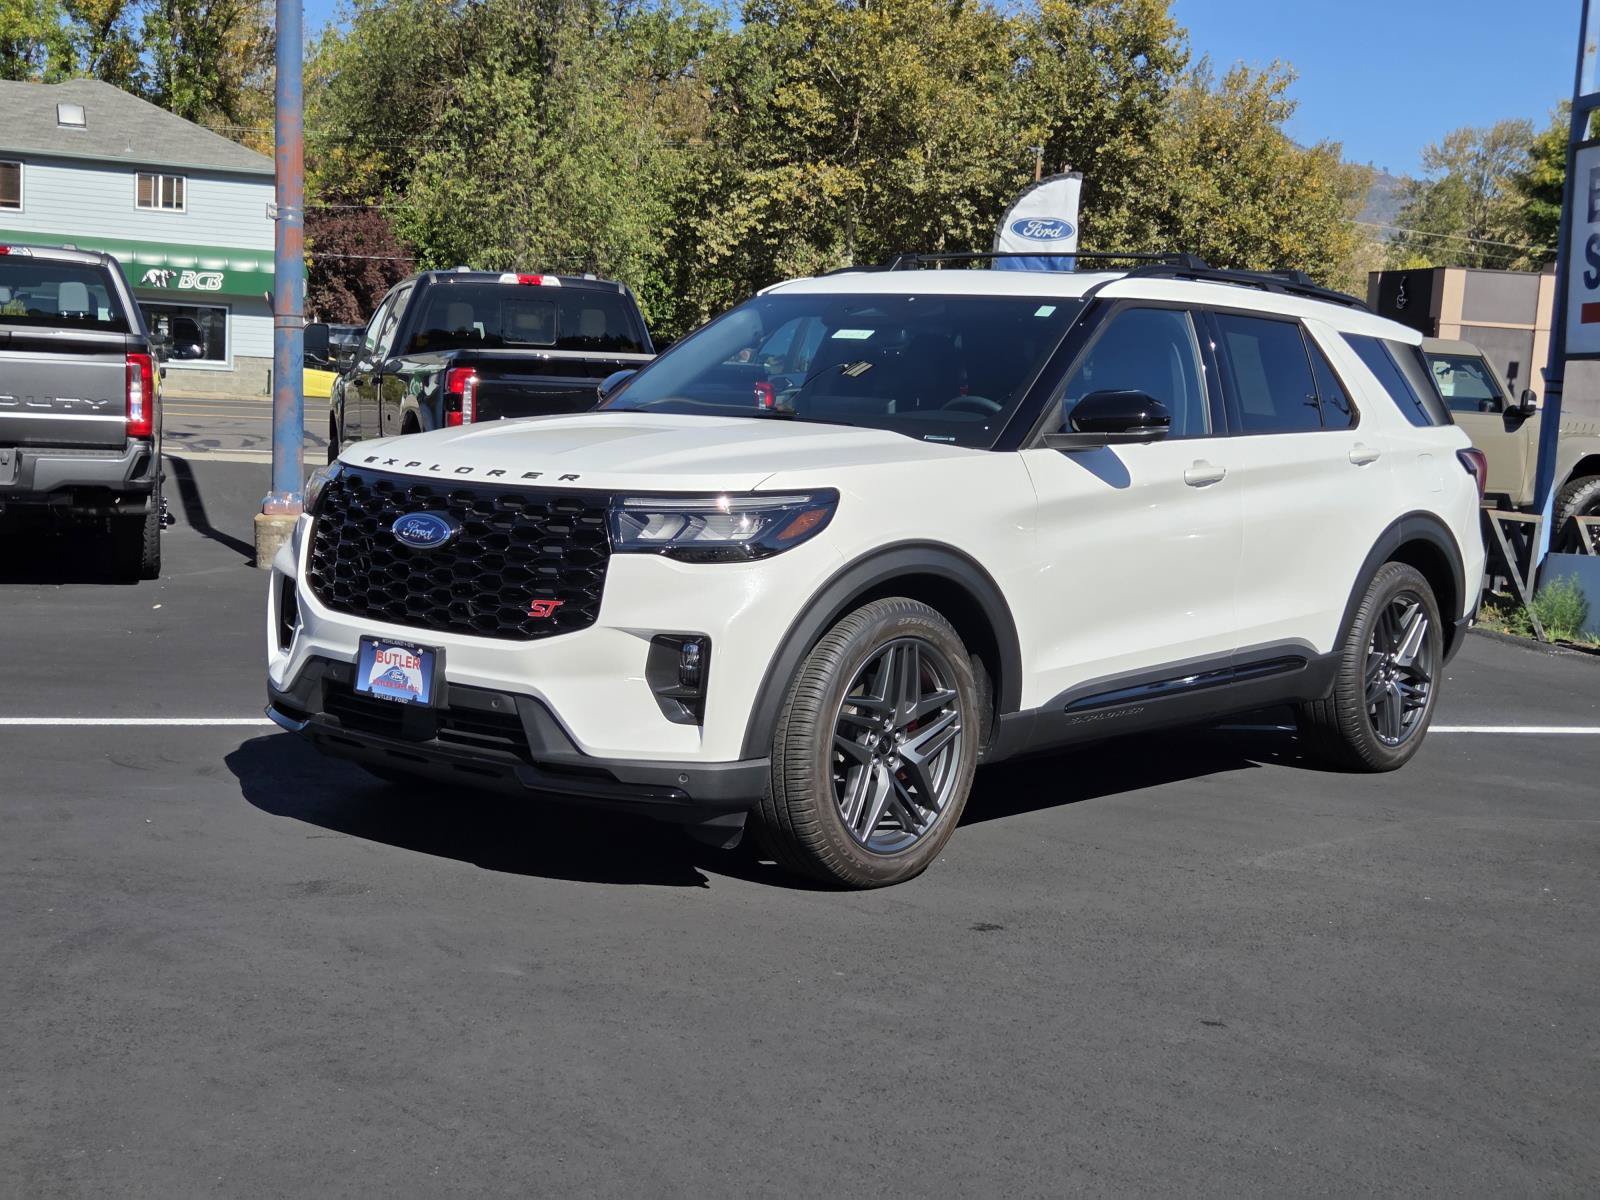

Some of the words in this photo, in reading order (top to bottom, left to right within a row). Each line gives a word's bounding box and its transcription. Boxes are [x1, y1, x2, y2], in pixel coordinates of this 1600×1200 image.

[1023, 220, 1063, 238] Ford
[178, 269, 224, 290] BCB
[0, 393, 108, 410] DUTY
[363, 455, 581, 482] EXPLORER
[403, 520, 436, 540] Ford
[528, 599, 564, 617] ST
[375, 649, 421, 669] BUTLER
